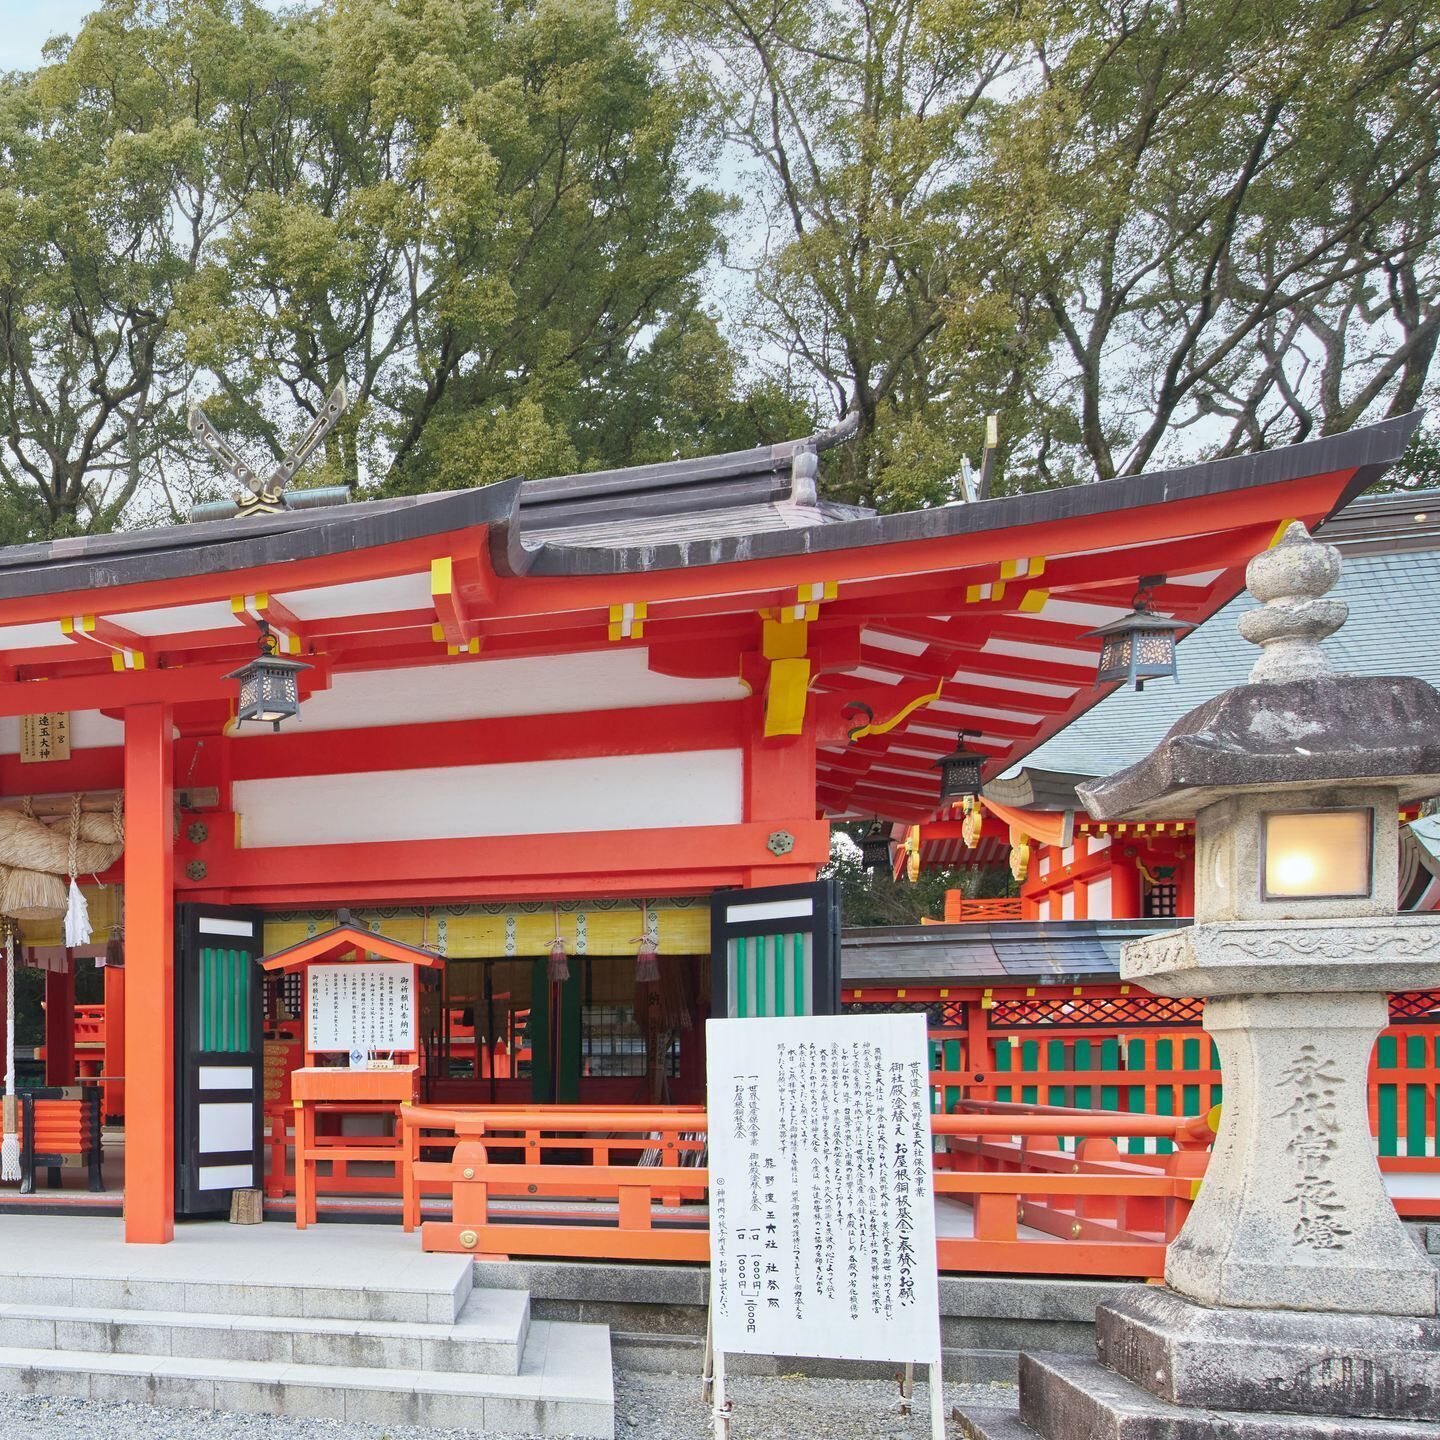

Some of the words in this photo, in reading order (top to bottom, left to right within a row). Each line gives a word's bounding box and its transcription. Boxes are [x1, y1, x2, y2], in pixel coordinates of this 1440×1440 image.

[38, 712, 50, 759] 速玉大神
[888, 1062, 909, 1136] 御社殿塗替え
[907, 1060, 922, 1097] 世界遺産
[1272, 1044, 1352, 1251] 永代常夜燈
